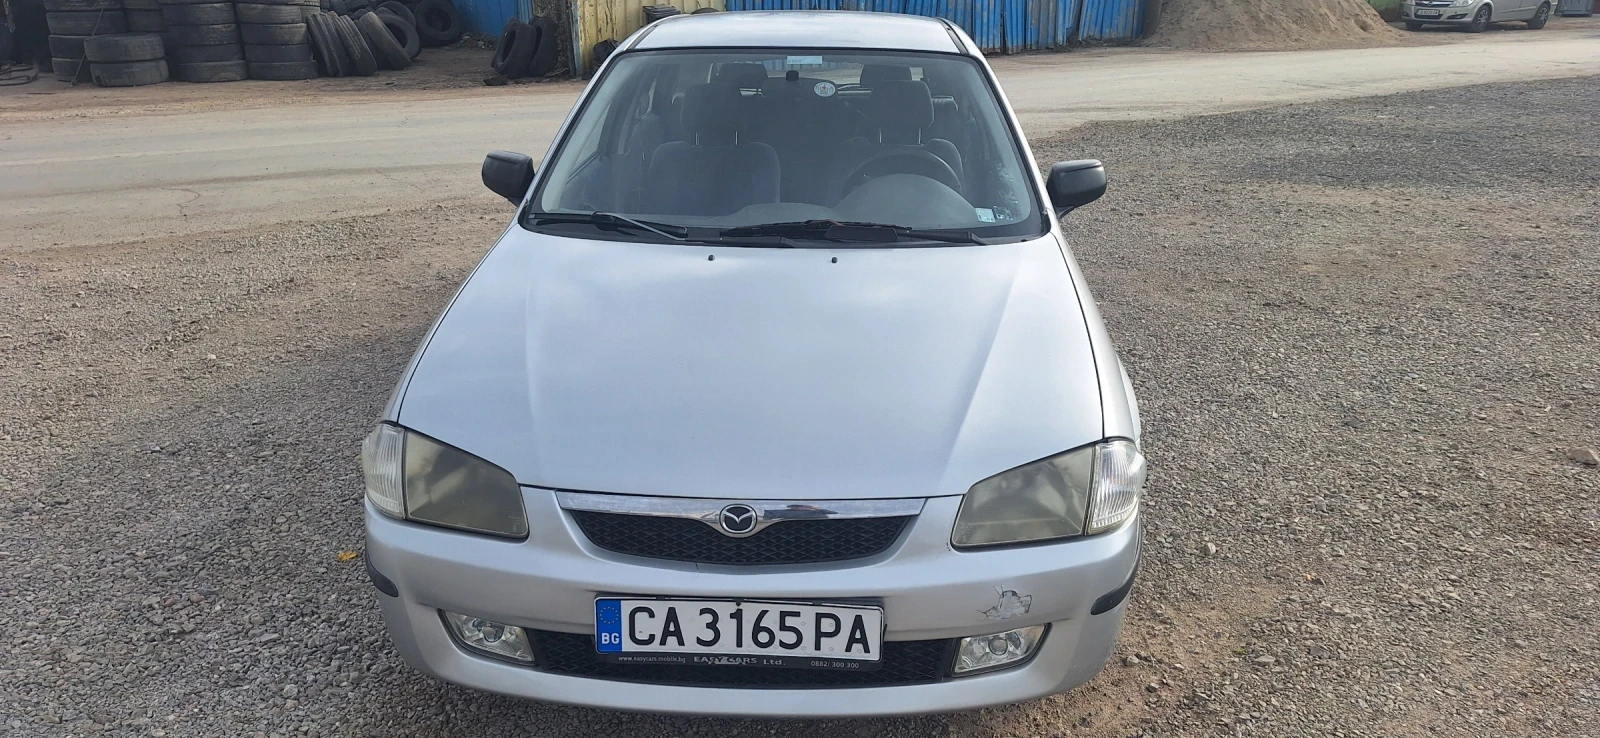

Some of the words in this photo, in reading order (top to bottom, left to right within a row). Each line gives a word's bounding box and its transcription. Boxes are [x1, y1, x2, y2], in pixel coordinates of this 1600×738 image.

[629, 606, 686, 647] CA
[696, 607, 803, 650] 3165
[814, 612, 871, 654] PA
[601, 633, 620, 645] BG
[618, 655, 686, 664] www.easycars.mobile.bg
[694, 656, 724, 664] EASY
[727, 656, 758, 665] CARS
[763, 658, 786, 666] Ltd.
